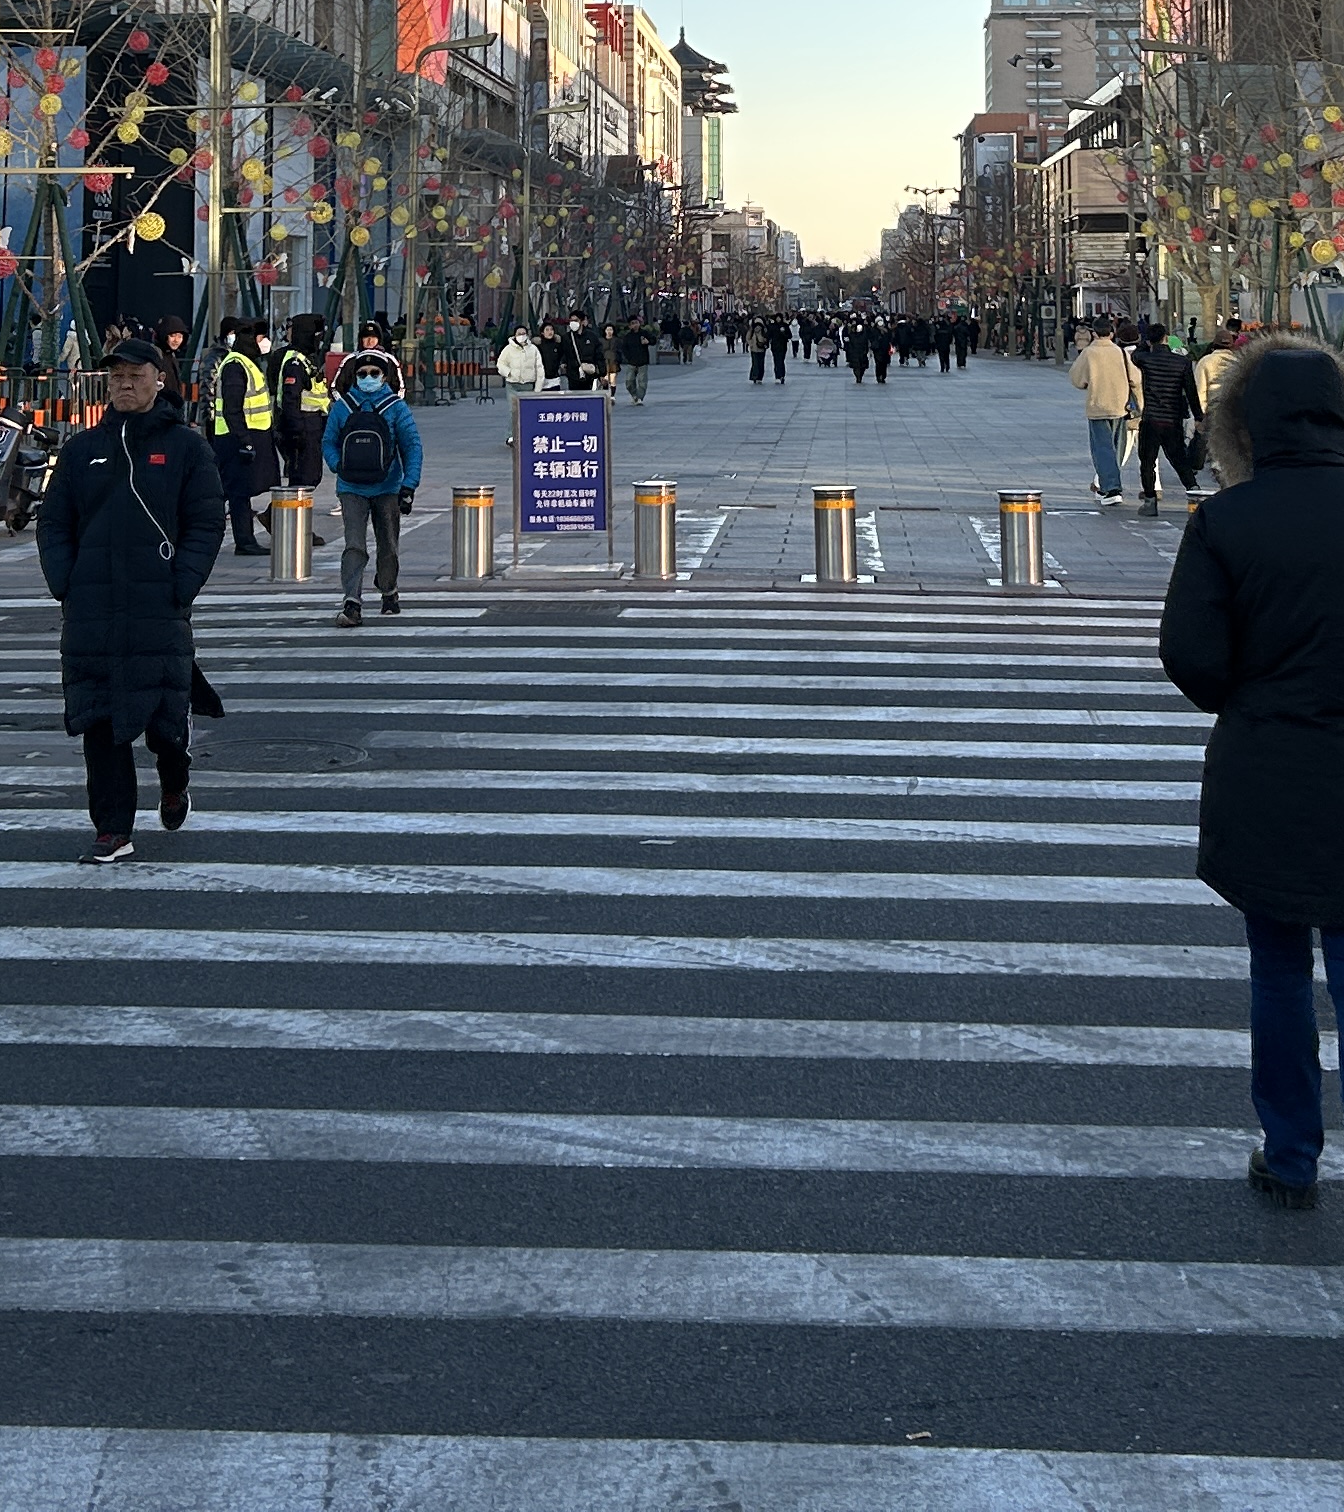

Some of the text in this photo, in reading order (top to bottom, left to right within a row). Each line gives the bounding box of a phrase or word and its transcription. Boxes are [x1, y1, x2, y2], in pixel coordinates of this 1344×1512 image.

[538, 412, 588, 423] 王府井步行街
[533, 435, 598, 453] 禁止一切
[533, 460, 599, 479] 车辆通行
